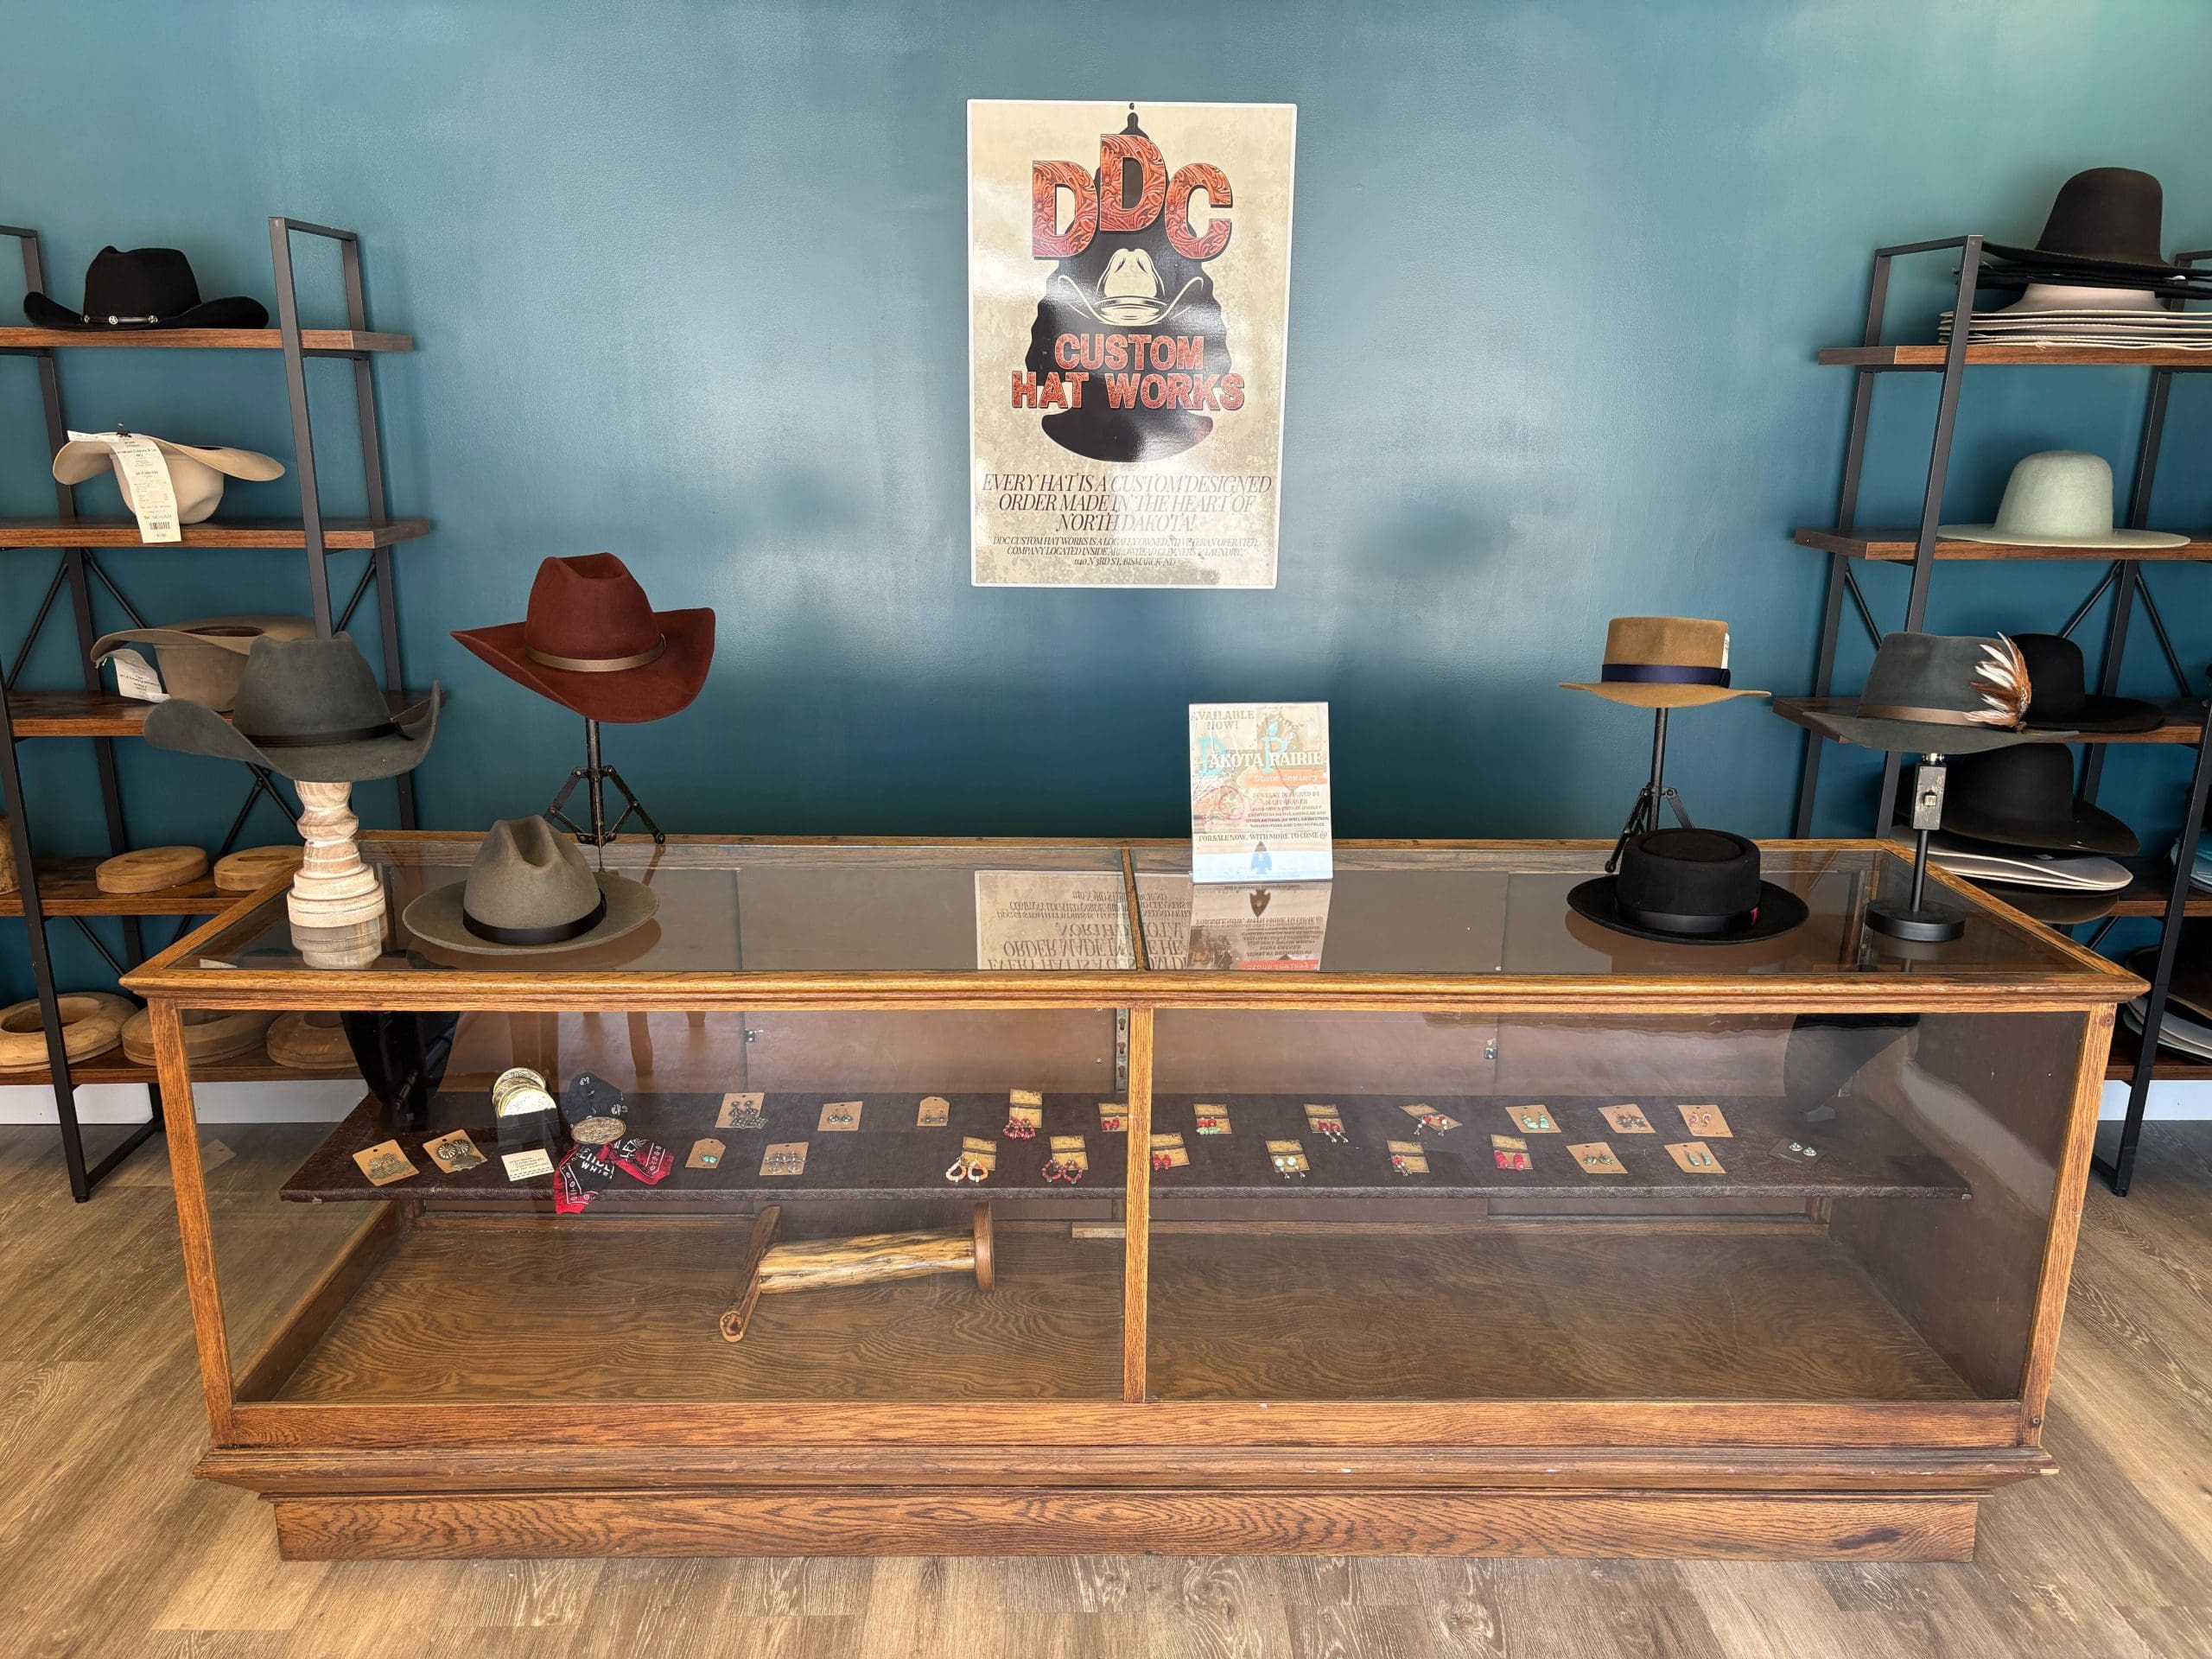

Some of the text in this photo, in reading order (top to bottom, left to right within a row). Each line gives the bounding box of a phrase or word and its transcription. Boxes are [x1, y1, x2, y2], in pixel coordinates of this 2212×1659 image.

[1032, 134, 1233, 261] DDC
[1054, 333, 1205, 371] CUSTOM
[1011, 370, 1245, 410] HAT WORKS
[982, 473, 1273, 493] EVERY HAT IS A CUSTOM DESIGNED
[999, 493, 1257, 513] ORDER MADE IN THE HEART OF
[1055, 512, 1197, 532] NORTH DAKOTA!
[993, 536, 1011, 545] DDC
[1011, 536, 1045, 545] CUSTOM
[1043, 537, 1062, 545] HAT
[1061, 537, 1090, 546] WORKS
[1103, 537, 1139, 546] LOCALLY
[1007, 546, 1045, 556] COMPANY
[1046, 546, 1081, 556] LOCATED
[1081, 547, 1109, 556] INSIDE
[1087, 557, 1096, 566] N
[1095, 557, 1110, 567] 3RD
[1191, 710, 1255, 721] AVAILABLE
[1207, 721, 1238, 730] NOW!
